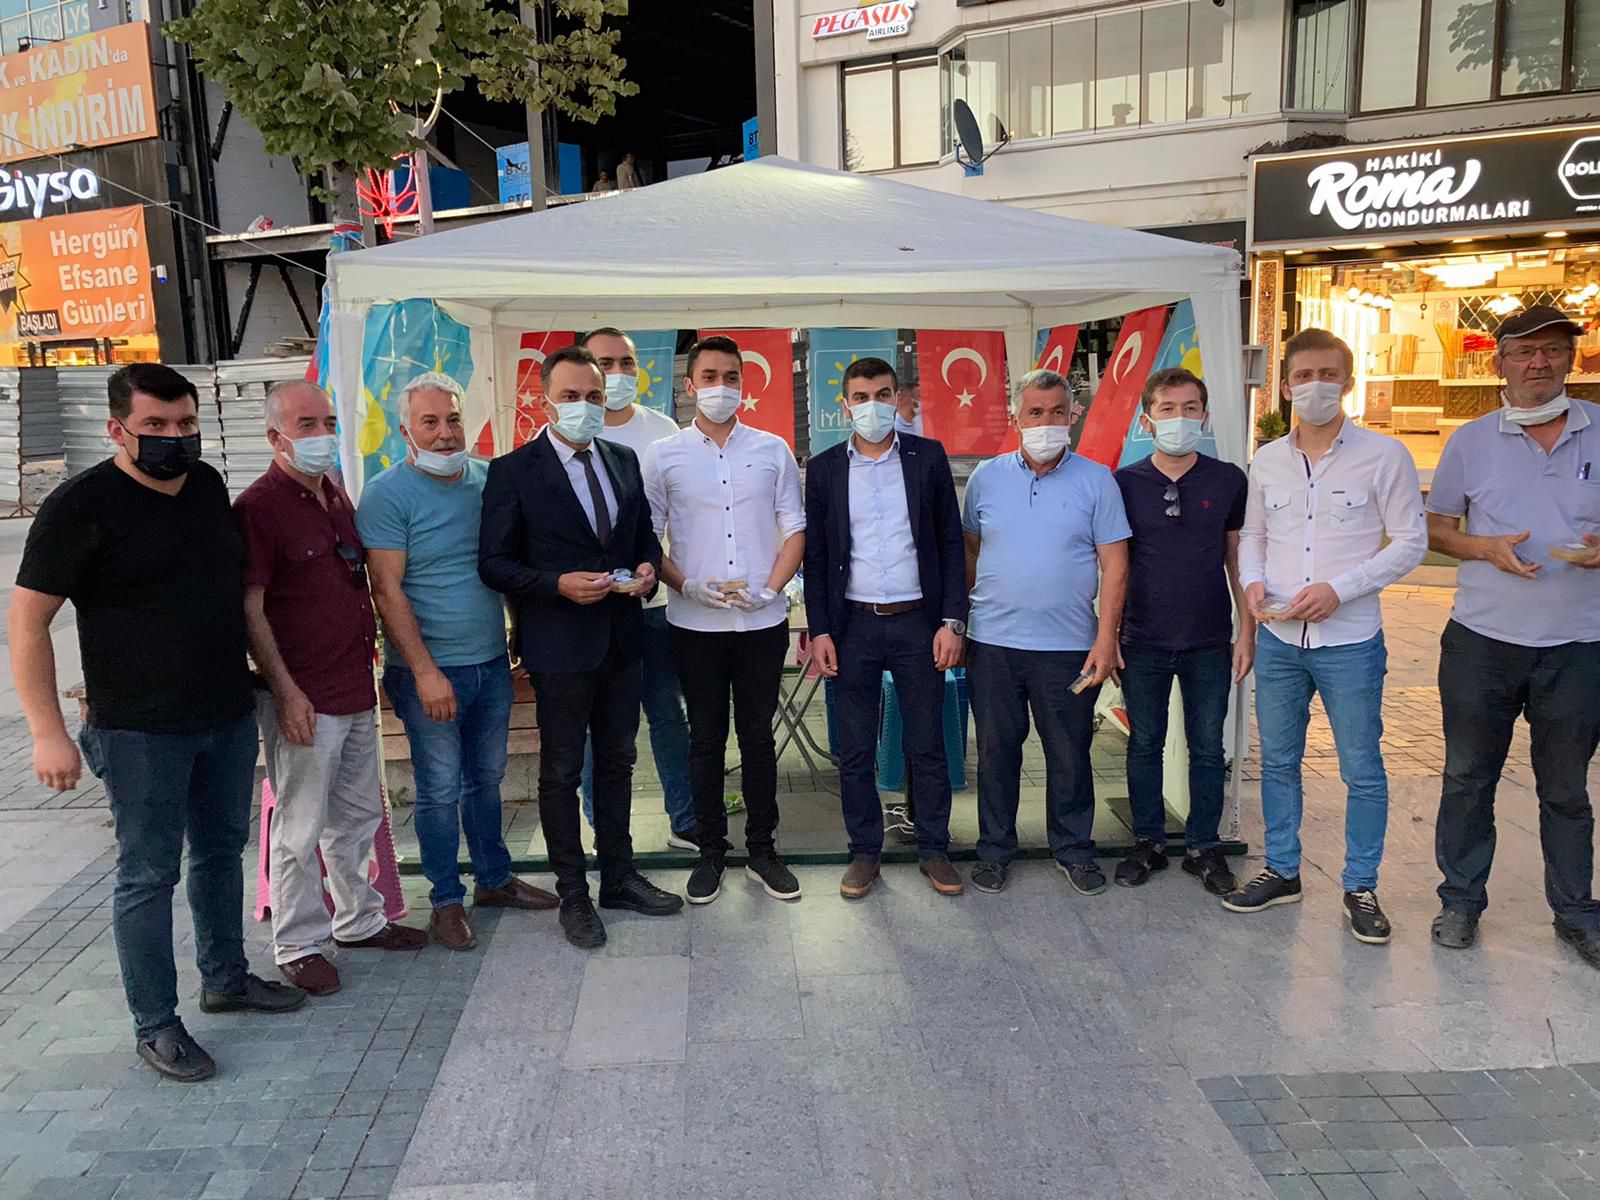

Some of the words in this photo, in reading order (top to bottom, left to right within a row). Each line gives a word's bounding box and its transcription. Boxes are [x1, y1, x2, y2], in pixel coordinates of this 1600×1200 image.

[64, 3, 90, 34] LYS
[813, 2, 911, 35] PEGASUS
[869, 24, 905, 37] AIRLINES
[14, 74, 26, 87] ve
[28, 78, 146, 151] İNDİRİM
[1366, 149, 1441, 172] HAKİKİ
[1308, 159, 1482, 229] Roma
[1365, 200, 1530, 229] DONDURMALARI
[50, 224, 138, 259] Hergün
[58, 264, 139, 291] Efsane
[20, 312, 58, 334] BAŞLADI
[63, 294, 146, 326] Günleri
